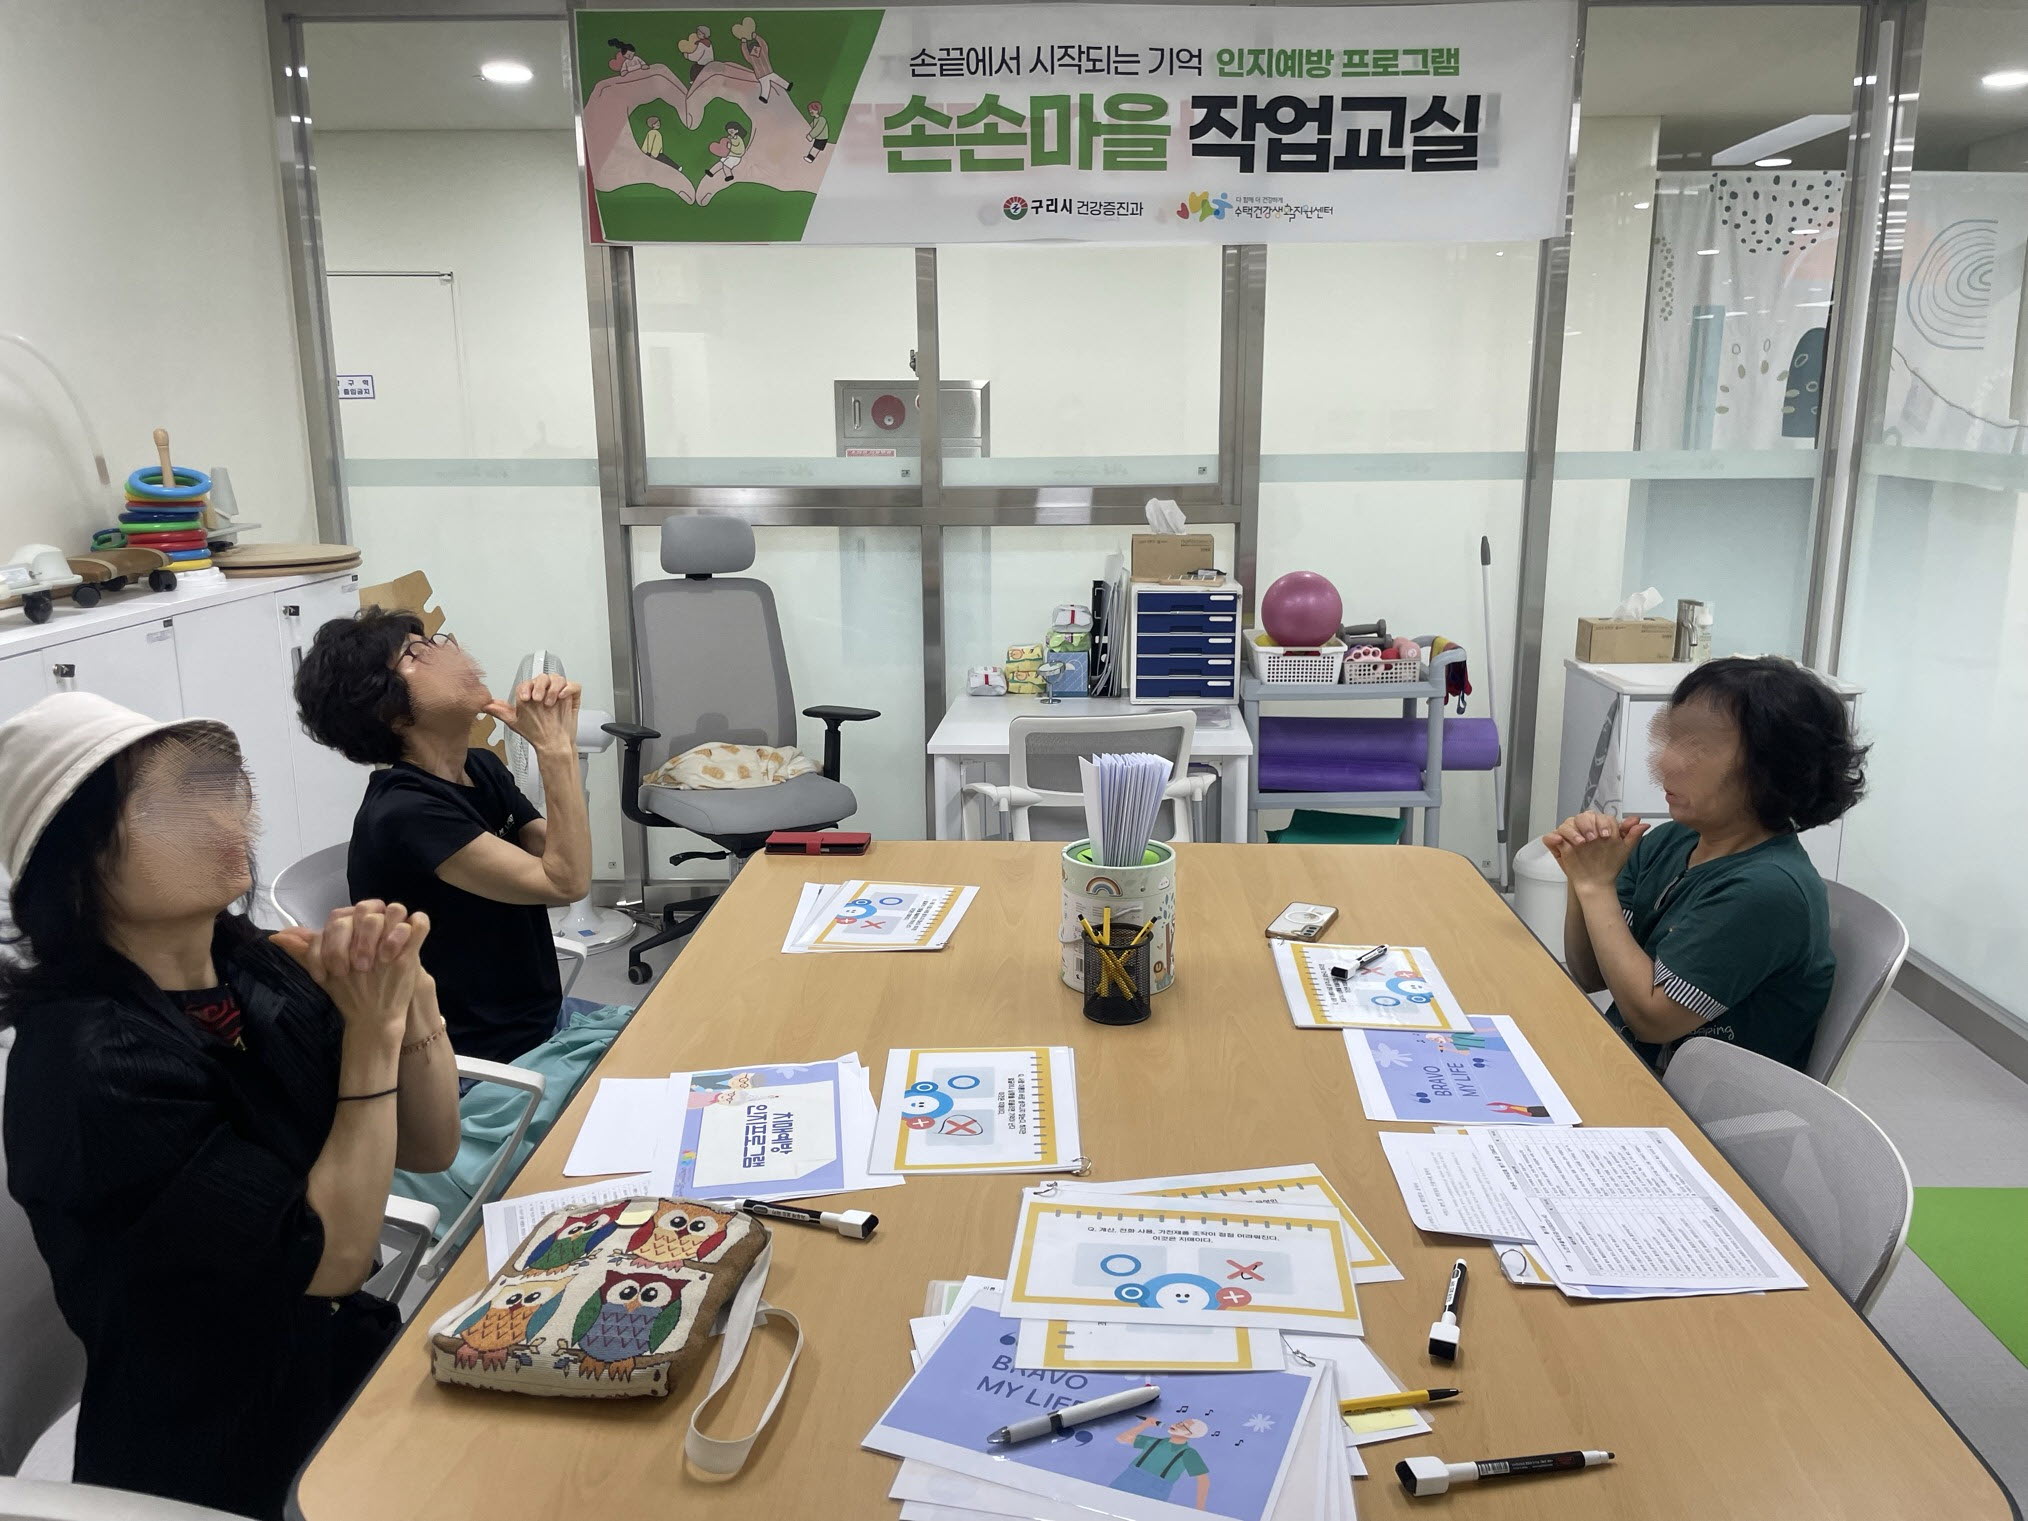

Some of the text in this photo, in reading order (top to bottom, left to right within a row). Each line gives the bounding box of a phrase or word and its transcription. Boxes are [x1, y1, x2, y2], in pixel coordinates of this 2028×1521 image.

[909, 44, 1460, 79] 손끝에서 시작되는 기억 인지예방 프로그램
[882, 93, 1482, 174] 손손마을 작업교실
[1030, 197, 1144, 217] 구리시 건강증진과
[1234, 203, 1334, 223] 수택건강생활지원센터
[1423, 1065, 1453, 1097] BRAVO
[1447, 1062, 1480, 1097] MY LIFE
[742, 1104, 768, 1169] 인지프로그램
[770, 1111, 794, 1155] 치매예방
[976, 1375, 1024, 1399] MY
[991, 1354, 1089, 1390] BAVO
